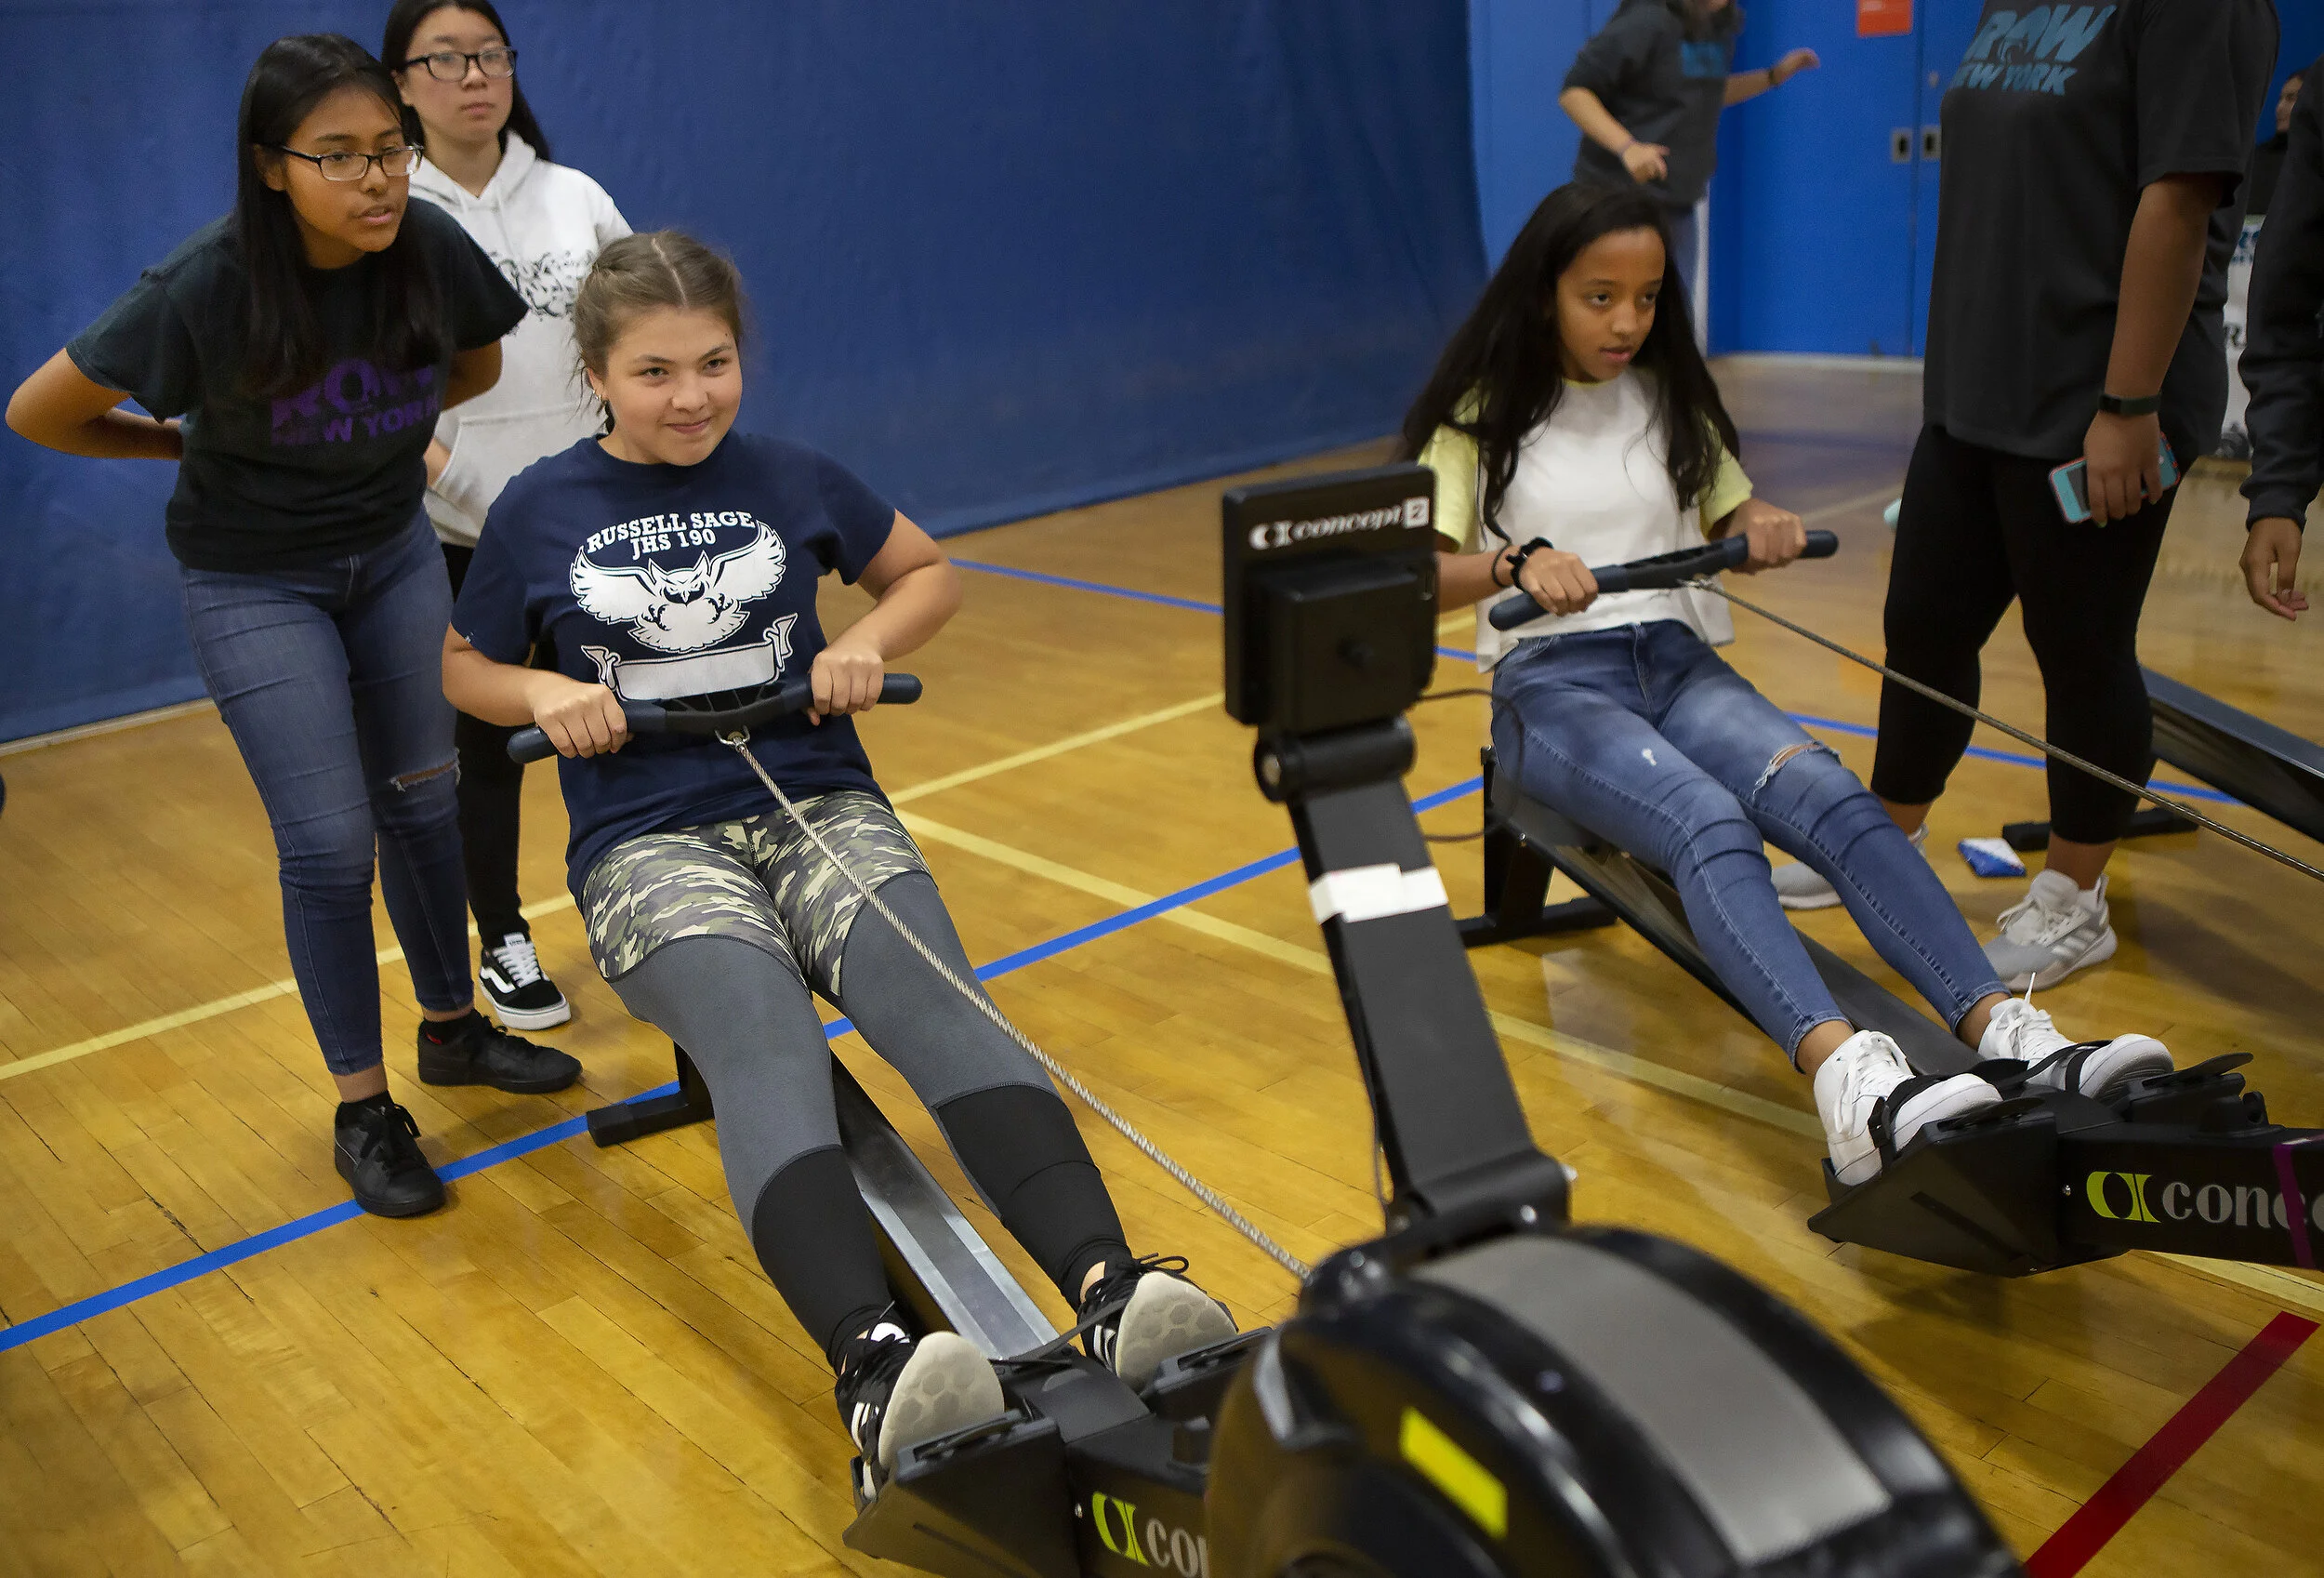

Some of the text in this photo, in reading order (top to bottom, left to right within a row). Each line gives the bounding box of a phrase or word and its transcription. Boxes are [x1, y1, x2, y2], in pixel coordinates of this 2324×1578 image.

[2001, 62, 2078, 96] YORK
[587, 511, 756, 554] RUSSELL SAGE
[630, 528, 717, 560] JHS 190
[2162, 1181, 2324, 1233] conc
